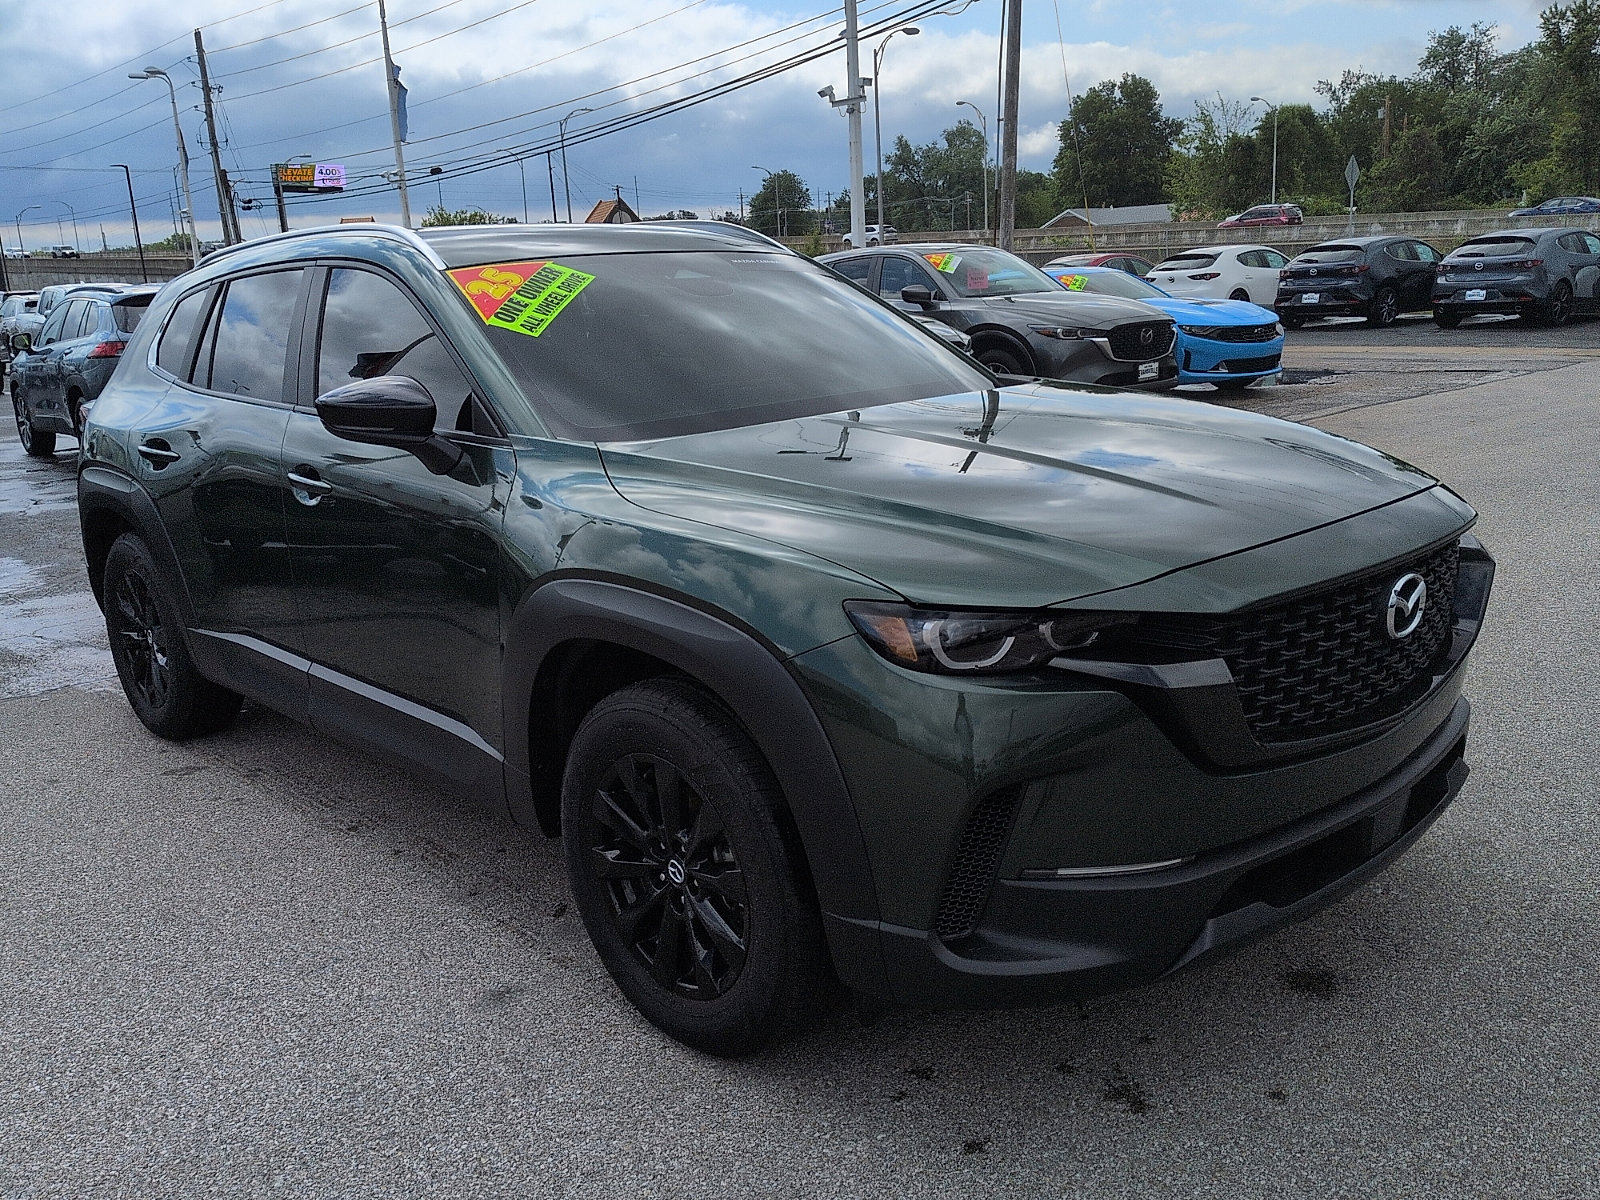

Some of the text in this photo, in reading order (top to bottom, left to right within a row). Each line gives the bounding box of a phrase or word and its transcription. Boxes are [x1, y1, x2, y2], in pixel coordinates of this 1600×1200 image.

[279, 168, 312, 176] ELEVATE
[466, 267, 524, 300] 25
[494, 266, 562, 323] ONE OWNER
[520, 273, 587, 333] ALL WHEEL DRIVE
